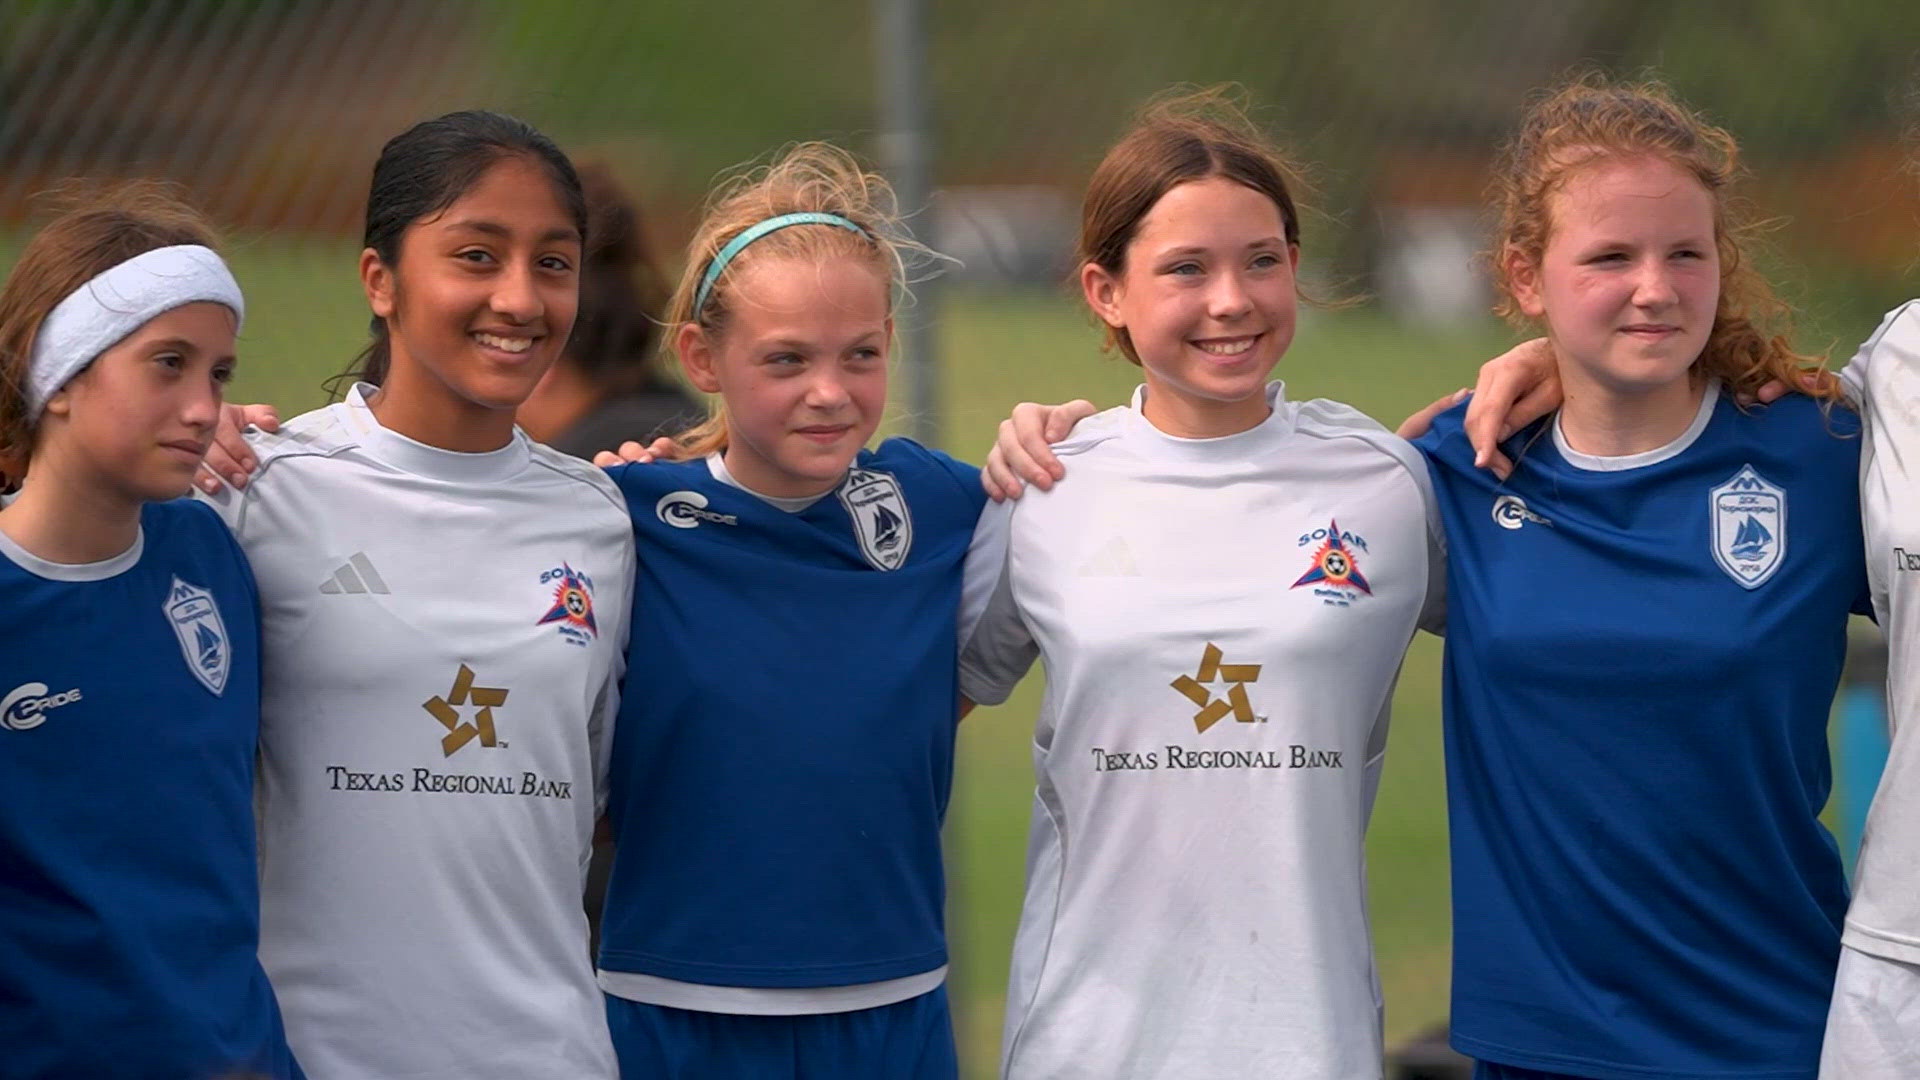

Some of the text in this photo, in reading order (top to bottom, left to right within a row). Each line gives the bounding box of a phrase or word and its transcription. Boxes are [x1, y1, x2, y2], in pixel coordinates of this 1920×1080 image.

[1298, 528, 1369, 555] SOLAR
[1091, 744, 1343, 771] TEXAS REGIONAL BANK
[326, 766, 572, 799] TEXAS REGIONAL BANK
